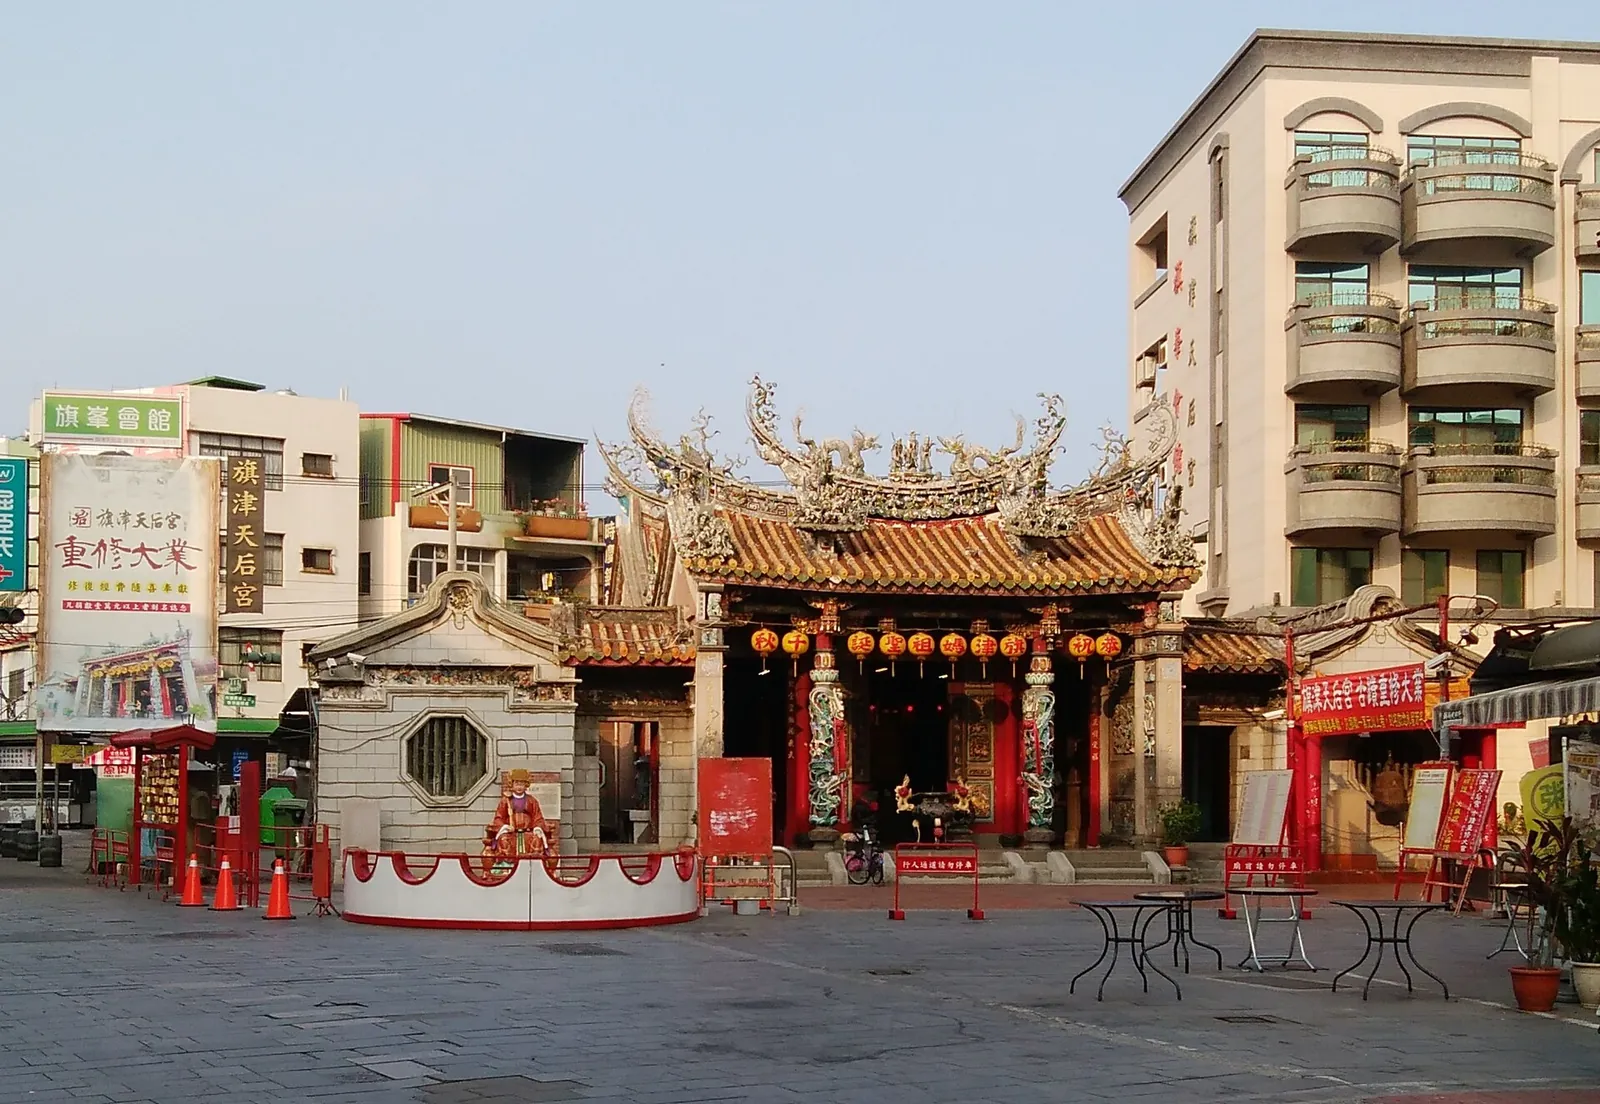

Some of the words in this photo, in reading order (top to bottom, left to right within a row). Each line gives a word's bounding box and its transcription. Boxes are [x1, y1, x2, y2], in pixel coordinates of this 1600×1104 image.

[96, 508, 182, 531] 旗津天后宮
[231, 458, 261, 608] 旗津天后宮
[54, 535, 203, 575] 重修大業
